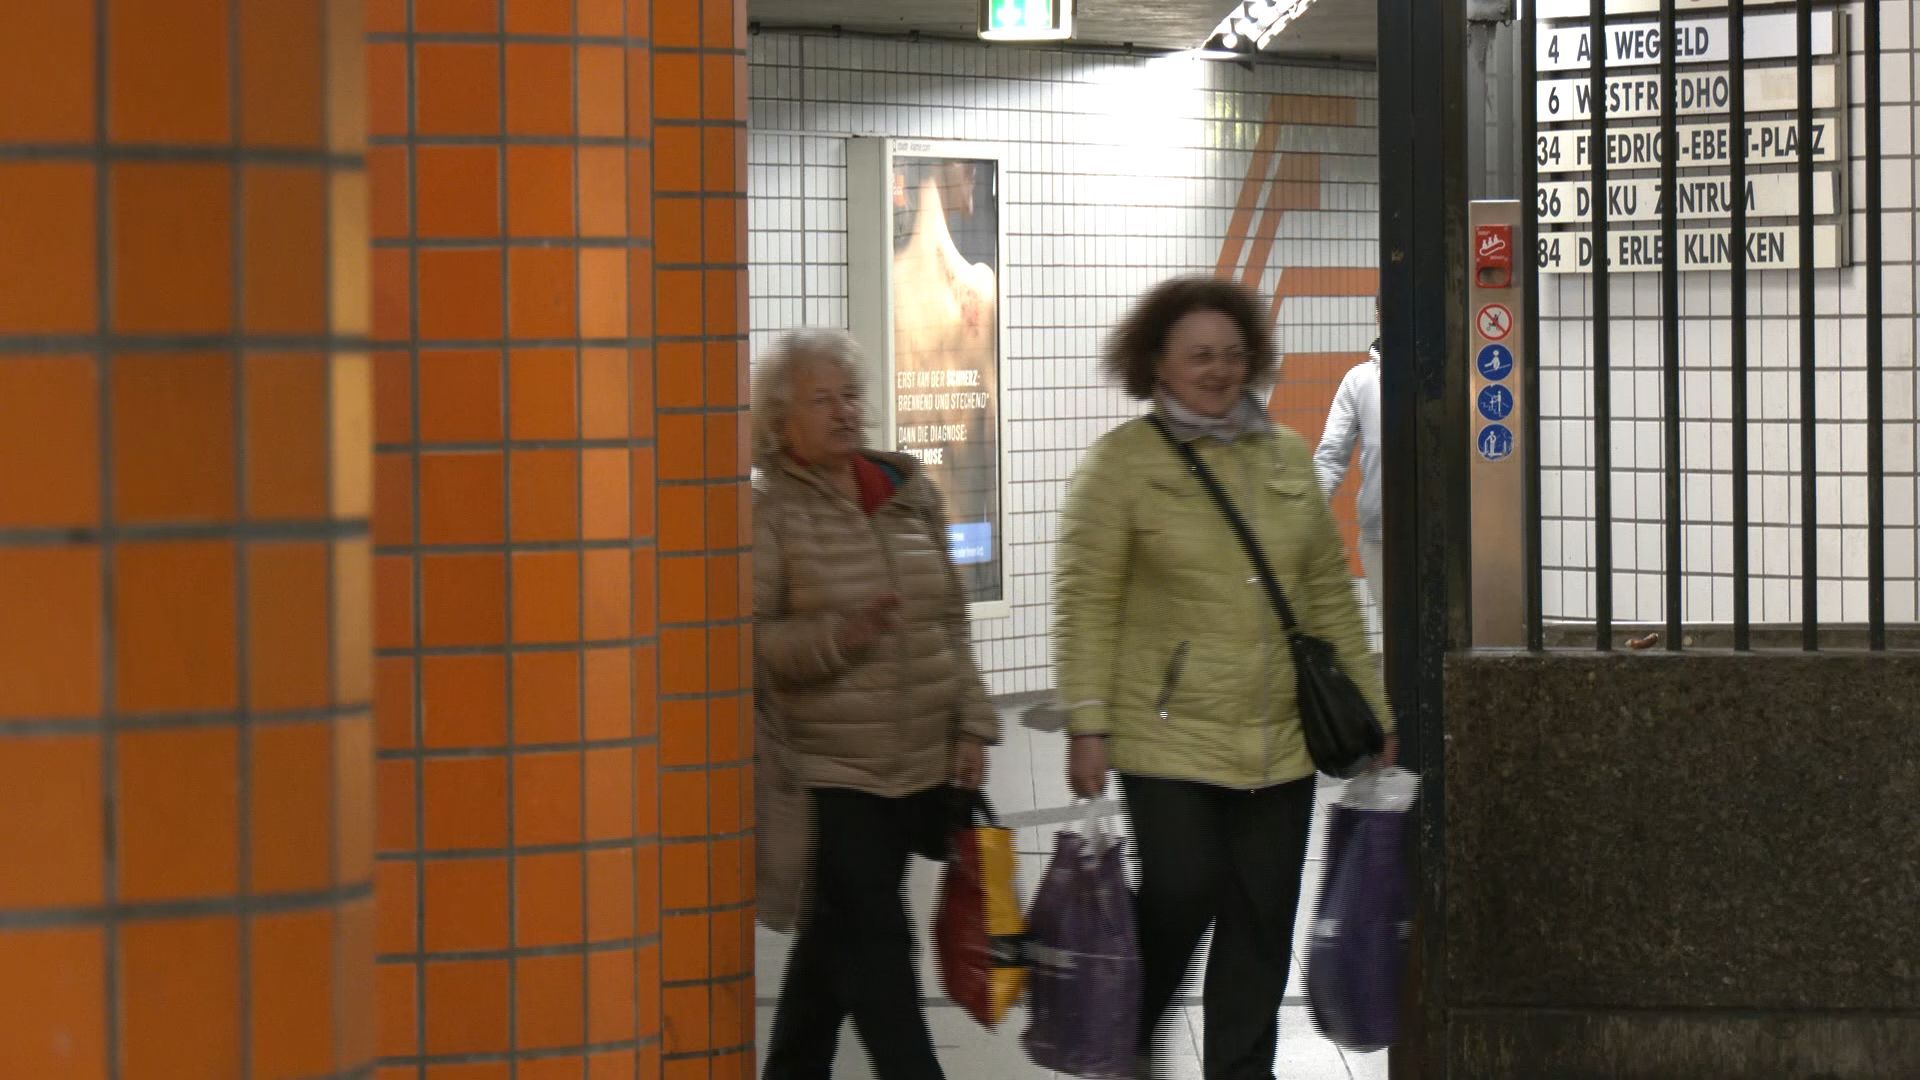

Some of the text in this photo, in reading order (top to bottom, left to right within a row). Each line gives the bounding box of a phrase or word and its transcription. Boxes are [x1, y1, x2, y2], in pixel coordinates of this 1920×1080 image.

[1548, 26, 1710, 65] 4 A WEGELD
[1548, 75, 1730, 115] 6 WSTFRDHO
[1537, 124, 1825, 167] 34 FEDRIC-EBET-PLAZ
[1537, 180, 1756, 218] 36 DKU ZNTRUM
[1537, 231, 1785, 268] 84 D. ERLE KLINKEN
[897, 371, 915, 389] ERST
[930, 370, 945, 388] DER
[898, 393, 933, 412] BRENNEND
[934, 392, 950, 411] UND
[917, 425, 929, 443] DIE
[930, 423, 968, 442] DIAGNOSE:
